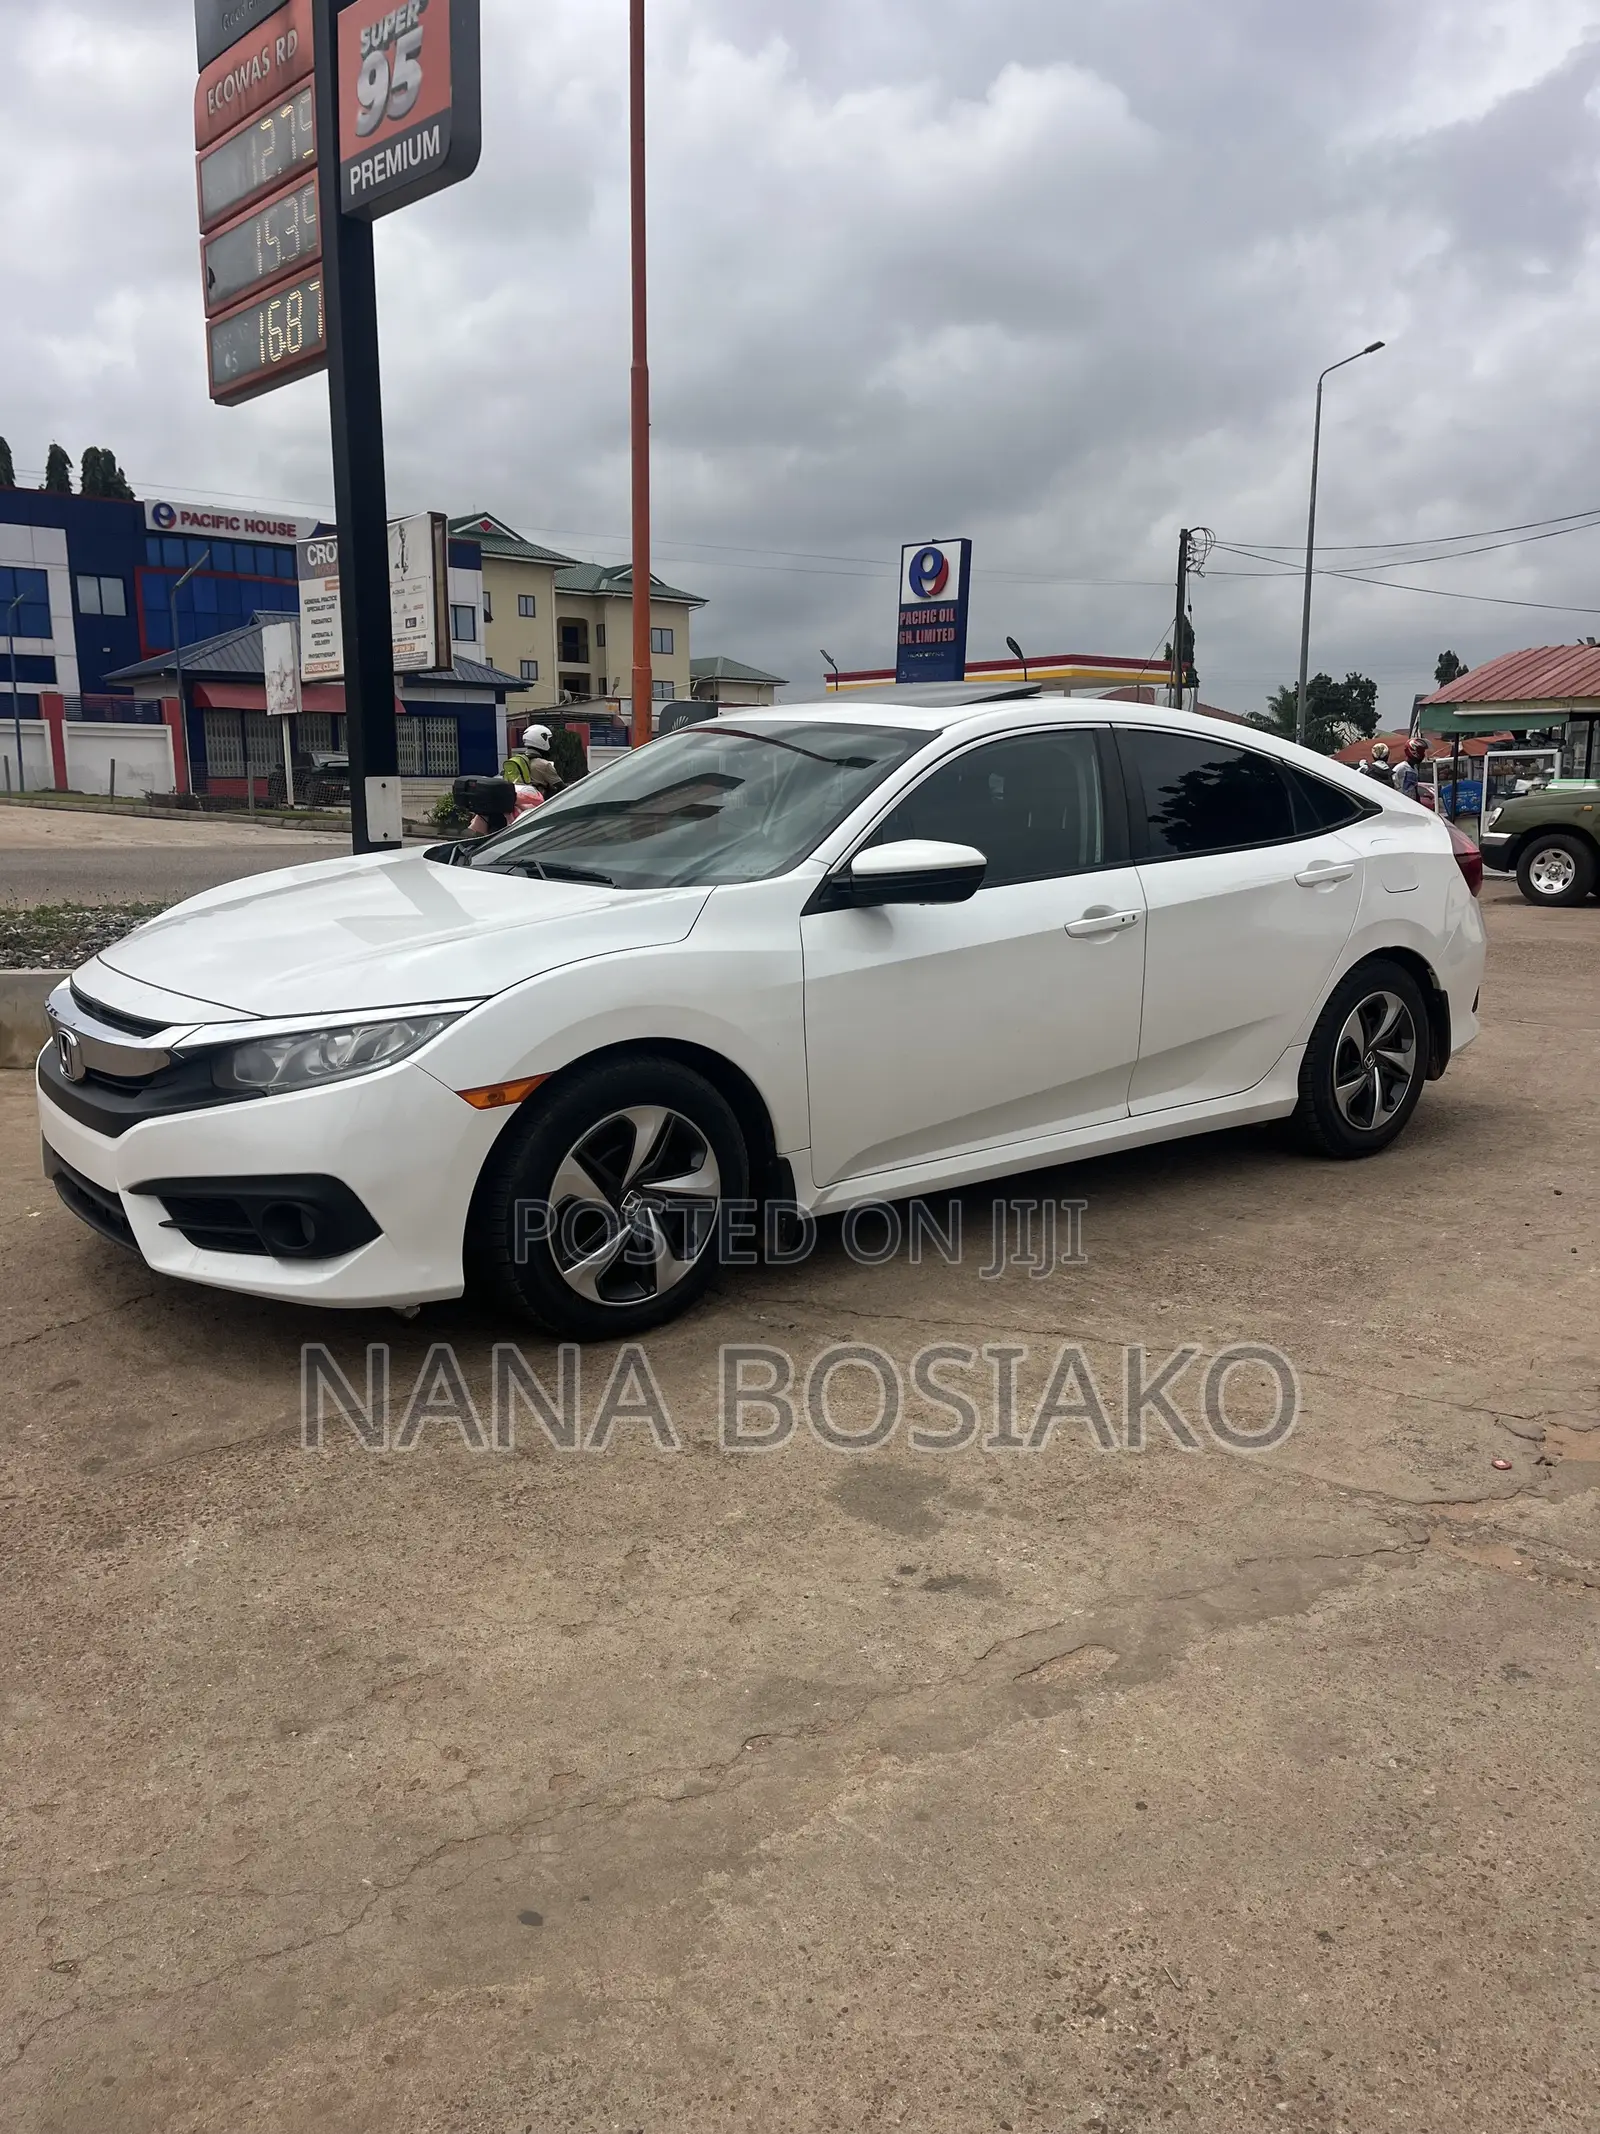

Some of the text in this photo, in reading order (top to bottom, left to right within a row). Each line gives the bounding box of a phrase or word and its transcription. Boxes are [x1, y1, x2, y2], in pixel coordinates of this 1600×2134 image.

[360, 0, 422, 54] SUPER
[207, 29, 298, 115] ECOWAS RD
[356, 26, 423, 137] 95
[350, 125, 440, 195] PREMIUM
[180, 511, 297, 538] PACIFIC HOUSE
[307, 541, 338, 566] CRO
[315, 563, 338, 577] HOSP
[900, 608, 954, 625] PACIFIC OIL
[899, 628, 954, 645] GH. LIMITED
[305, 661, 339, 673] DENTAL CLINIC
